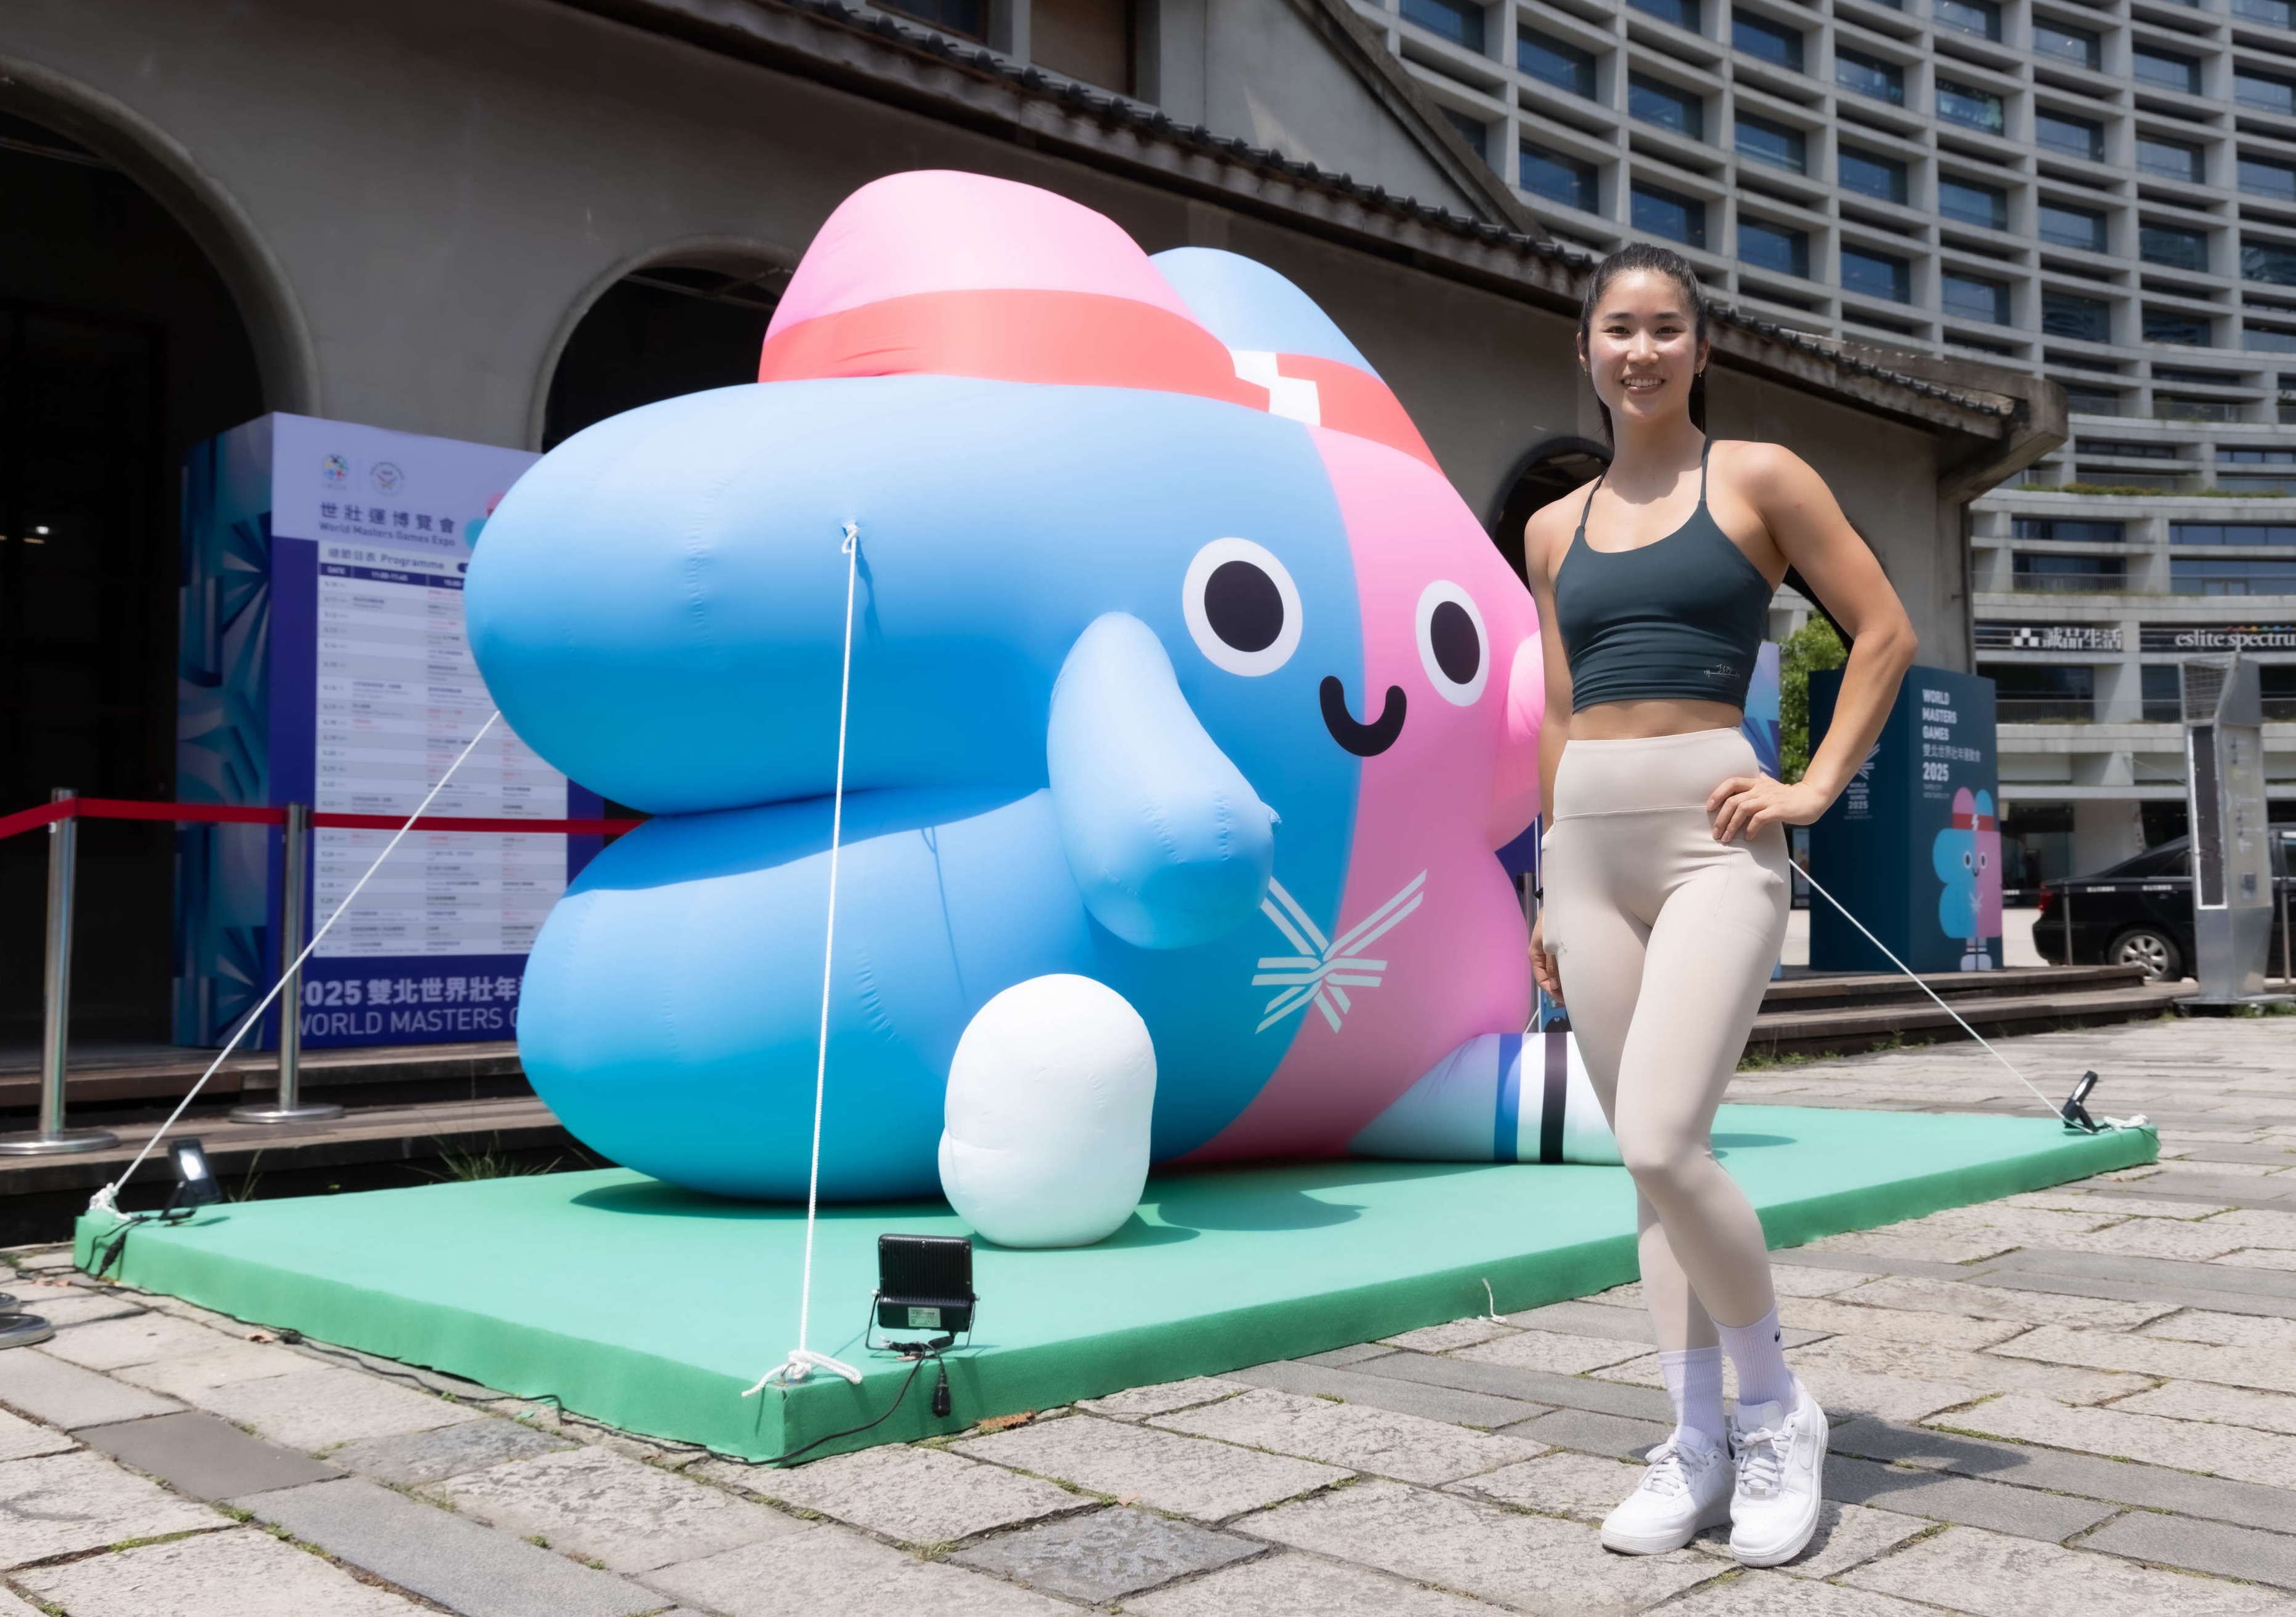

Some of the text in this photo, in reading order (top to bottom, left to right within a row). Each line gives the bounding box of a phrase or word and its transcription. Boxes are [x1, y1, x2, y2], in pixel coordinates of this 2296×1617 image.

[320, 502, 455, 534] 世壯運博覽會
[319, 522, 456, 547] World Masters Games Expo
[381, 554, 445, 569] Programme
[2042, 627, 2121, 649] 誠品生活
[2175, 629, 2225, 647] eslite
[1922, 689, 1950, 705] WORLD
[1922, 707, 1958, 724] MASTERS
[1922, 725, 1950, 741] GAMES
[1922, 762, 1949, 782] 2025
[300, 976, 524, 1006] 025 雙北世界壯年
[390, 1007, 503, 1033] MASTERS
